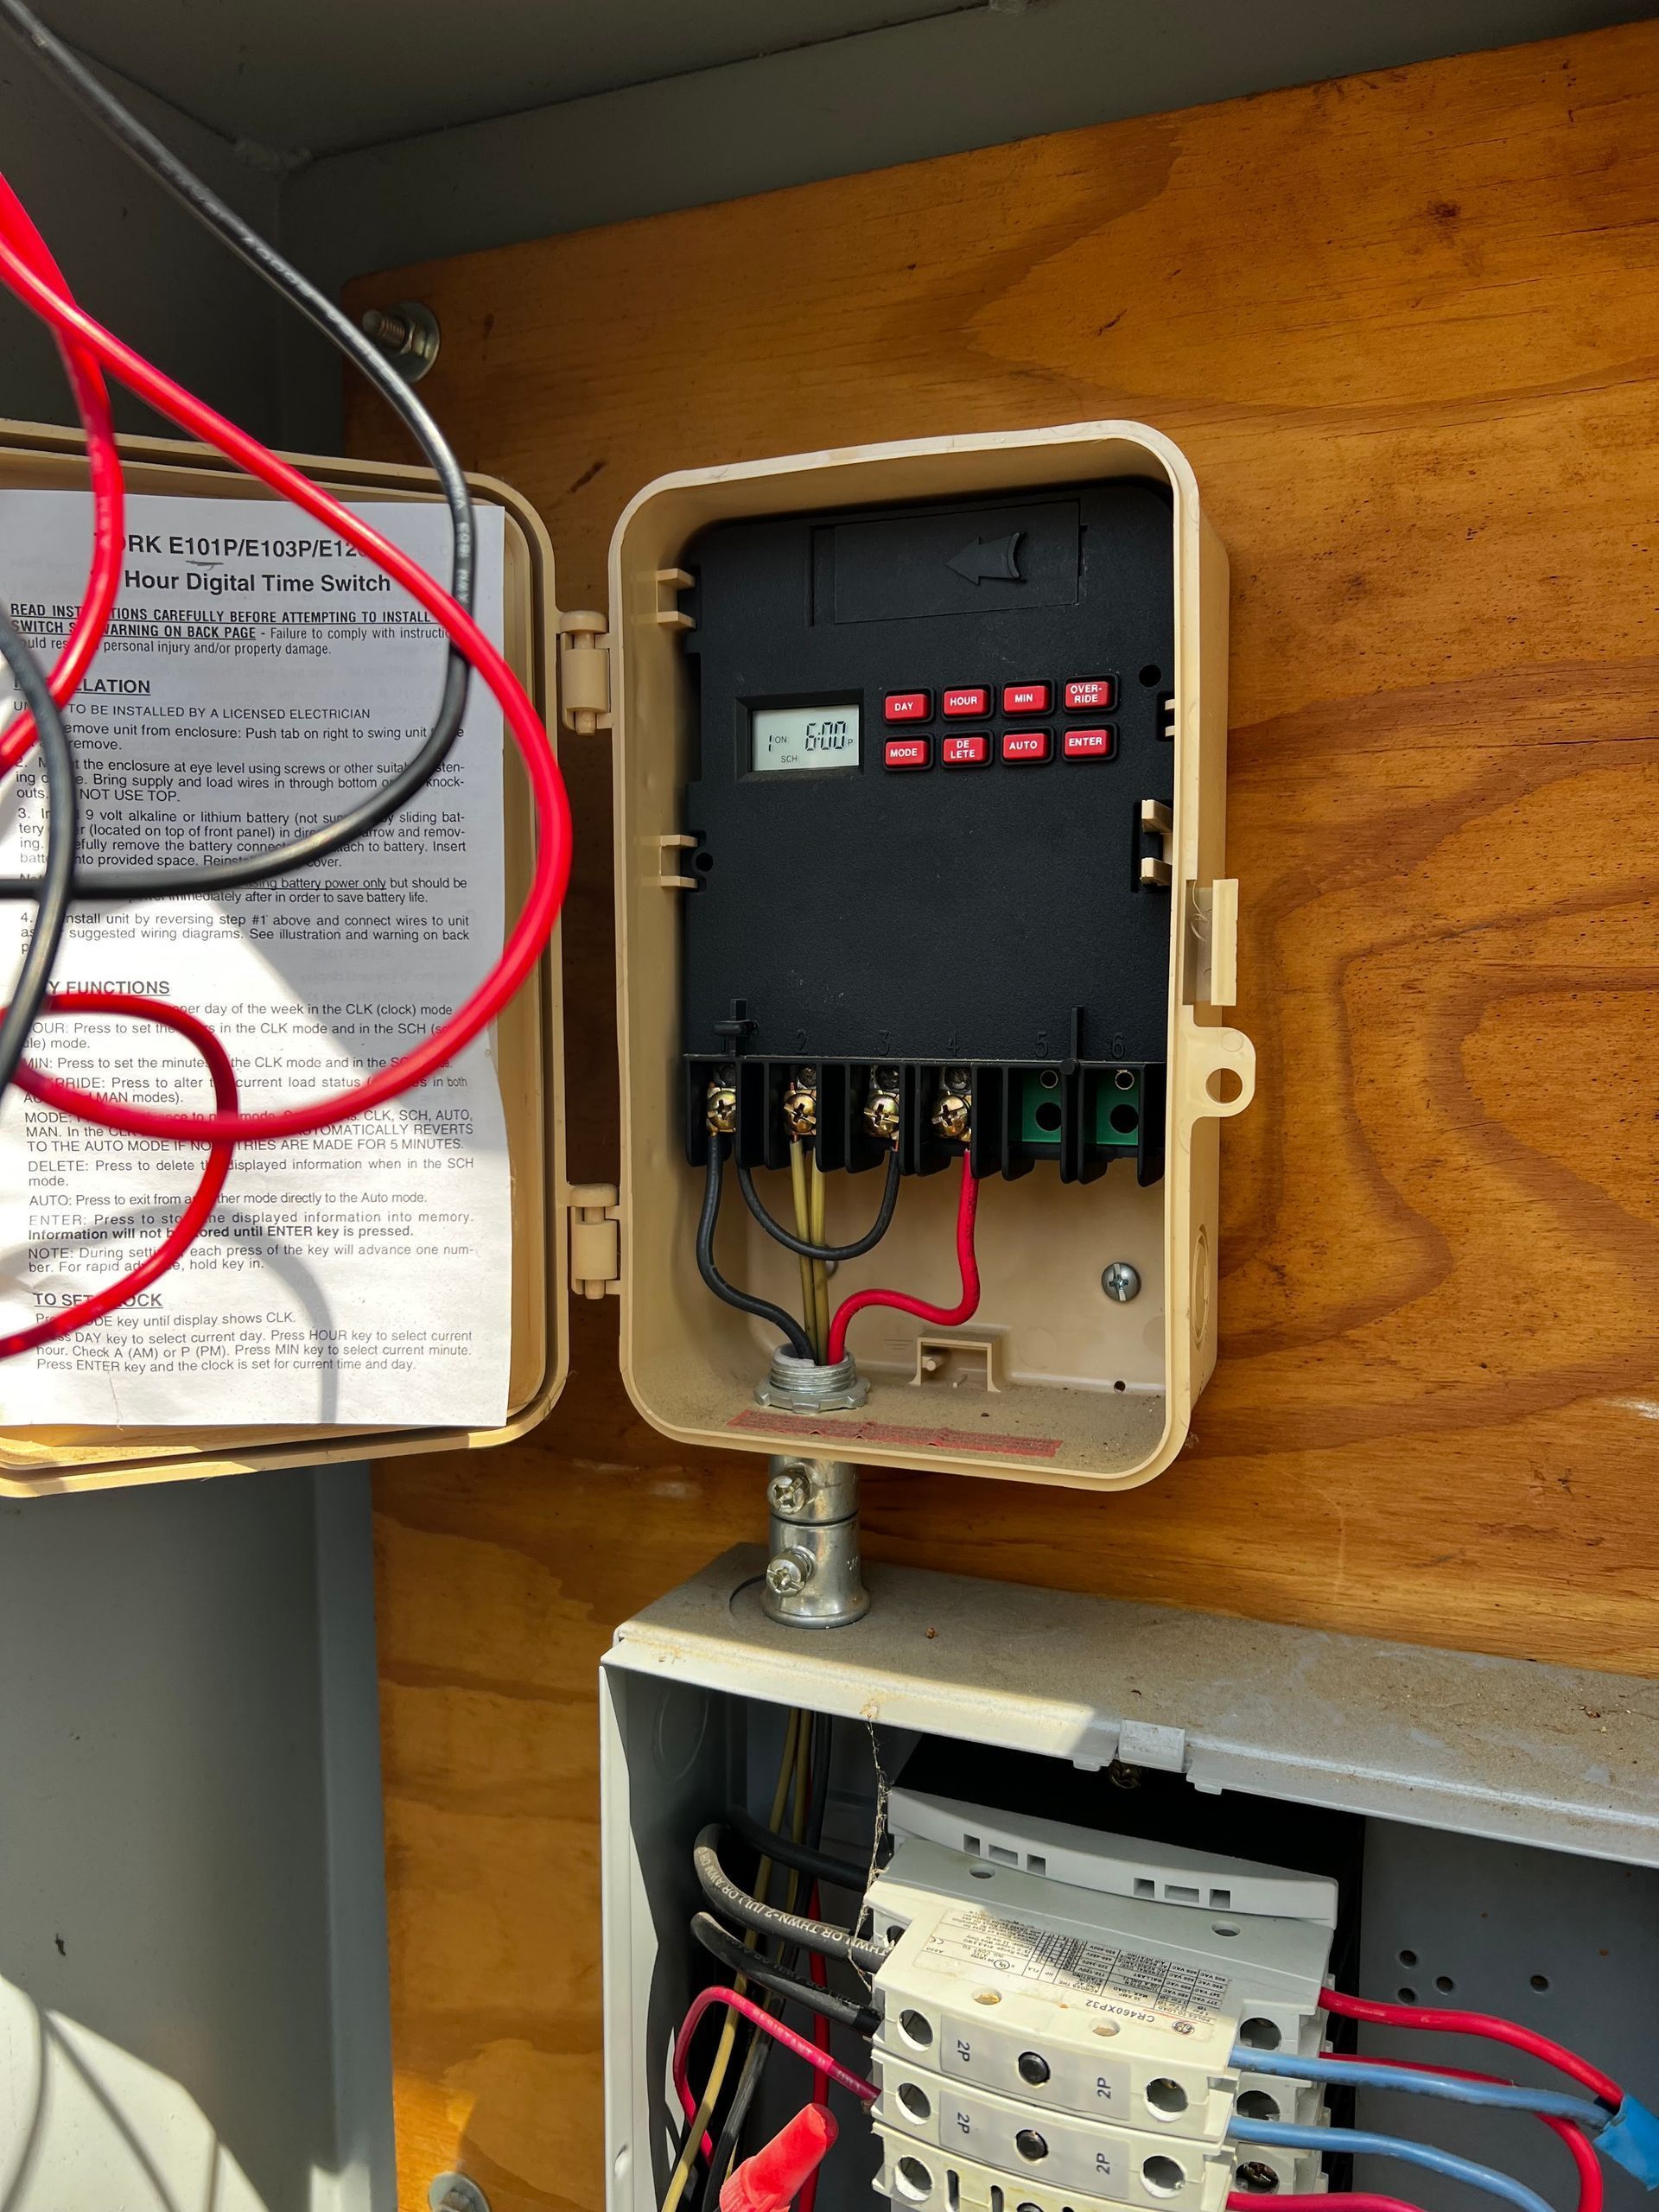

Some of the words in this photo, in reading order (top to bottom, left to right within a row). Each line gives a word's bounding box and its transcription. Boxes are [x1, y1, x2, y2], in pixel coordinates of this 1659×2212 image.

[124, 570, 180, 589] Hour
[187, 572, 255, 595] Digital
[262, 575, 315, 592] Time
[321, 574, 391, 592] Switch
[10, 604, 46, 616] READ
[153, 608, 225, 621] CAREFULLY
[230, 610, 276, 622] BEFORE
[282, 611, 357, 623] ATTEMPTING
[361, 611, 377, 623] TO
[383, 611, 432, 623] INSTALL
[13, 620, 63, 633] SWITCH
[164, 625, 181, 638] ON
[187, 626, 219, 639] BACK
[224, 626, 256, 639] PAGE
[270, 627, 307, 639] Failure
[311, 628, 323, 639] to
[327, 627, 367, 640] comply
[372, 627, 395, 638] with
[104, 641, 154, 652] personal
[157, 641, 190, 655] injury
[194, 643, 232, 653] and/or
[234, 644, 282, 657] property
[285, 644, 331, 657] damage.
[1014, 693, 1033, 703] MIN
[1070, 685, 1103, 696] OVER-
[950, 696, 977, 707] HOUR
[1074, 694, 1098, 703] RIDE
[68, 704, 86, 714] TO
[91, 705, 109, 715] BE
[112, 706, 185, 716] INSTALLED
[188, 708, 207, 717] BY
[223, 709, 286, 719] LICENSED
[289, 709, 370, 719] ELECTRICIAN
[894, 702, 914, 712] DAY
[113, 724, 137, 734] unit
[141, 725, 171, 735] from
[175, 727, 241, 738] enclosure:
[245, 728, 276, 739] Push
[280, 728, 301, 739] tab
[322, 728, 349, 741] right
[352, 729, 364, 738] to
[367, 727, 401, 741] swing
[405, 728, 427, 737] unit
[774, 736, 787, 745] ON
[804, 721, 847, 752] 6:00
[956, 740, 969, 750] DE
[1009, 740, 1038, 751] AUTO
[1068, 736, 1103, 747] ENTER
[780, 754, 798, 764] SCH
[890, 747, 918, 759] MODE
[950, 749, 976, 759] LETE
[83, 759, 104, 770] the
[108, 760, 170, 772] enclosure
[174, 762, 187, 772] at
[189, 764, 213, 775] eye
[216, 763, 245, 773] level
[248, 763, 281, 776] using
[344, 764, 374, 773] other
[93, 774, 127, 788] Bring
[131, 776, 174, 789] supply
[178, 777, 201, 787] and
[207, 777, 233, 787] load
[237, 778, 270, 788] wires
[274, 778, 285, 788] in
[289, 778, 334, 791] through
[338, 778, 378, 788] bottom
[79, 789, 108, 799] NOT
[114, 790, 144, 801] USE
[147, 791, 181, 801] TOP.
[86, 810, 94, 820] 9
[99, 810, 123, 820] volt
[128, 810, 177, 822] alkaline
[200, 811, 242, 822] lithium
[246, 812, 289, 826] battery
[295, 813, 318, 825] (not
[245, 892, 273, 902] after
[275, 892, 286, 902] in
[289, 893, 321, 902] order
[322, 893, 334, 902] to
[366, 892, 406, 905] battery
[409, 892, 428, 902] life.
[249, 928, 275, 939] See
[279, 929, 341, 939] illustration
[345, 930, 368, 939] and
[372, 930, 419, 943] warning
[442, 930, 470, 940] back
[308, 1004, 319, 1014] in
[321, 1004, 342, 1014] the
[346, 1004, 373, 1014] CLK
[376, 1005, 416, 1016] (clock)
[420, 1005, 453, 1014] mode
[1036, 1033, 1049, 1058] 5
[1111, 1033, 1124, 1058] 6
[364, 1110, 395, 1122] CLK,
[398, 1110, 432, 1122] SCH,
[435, 1109, 473, 1121] AUTO,
[280, 1140, 309, 1150] ARE
[313, 1140, 353, 1149] MADE
[357, 1139, 386, 1149] FOR
[390, 1140, 398, 1149] 5
[401, 1138, 464, 1149] MINUTES.
[29, 1229, 108, 1239] Information
[111, 1228, 136, 1238] will
[139, 1229, 162, 1238] not
[233, 1226, 263, 1236] until
[267, 1226, 313, 1236] ENTER
[316, 1226, 340, 1238] key
[343, 1224, 354, 1236] is
[358, 1226, 414, 1238] pressed.
[37, 1359, 73, 1370] Press
[76, 1360, 120, 1371] ENTER
[124, 1362, 146, 1375] key
[149, 1361, 174, 1372] and
[177, 1361, 198, 1371] the
[200, 1360, 234, 1370] clock
[238, 1359, 248, 1369] is
[251, 1359, 270, 1369] set
[274, 1358, 290, 1369] for
[292, 1359, 334, 1369] current
[336, 1360, 362, 1369] time
[365, 1359, 388, 1369] and
[391, 1359, 416, 1371] day.
[722, 1884, 741, 1899] OR
[764, 1908, 818, 1934] THWN-2
[822, 1927, 843, 1942] OR
[1085, 1999, 1155, 2023] CR460XP32
[957, 2039, 971, 2063] 2P
[1097, 2076, 1112, 2100] 2P
[957, 2112, 971, 2135] 2P
[1096, 2152, 1111, 2175] 2P
